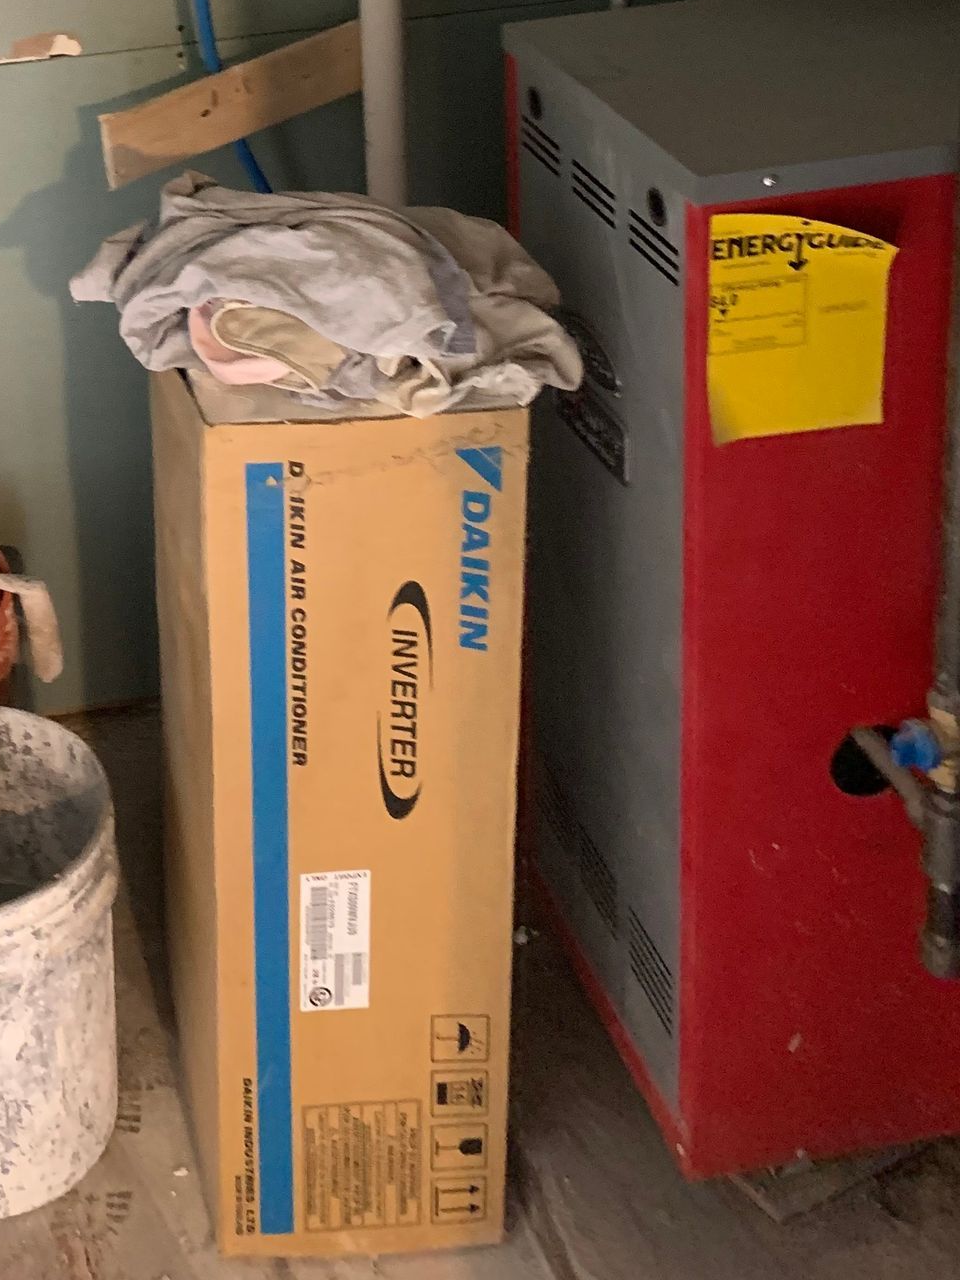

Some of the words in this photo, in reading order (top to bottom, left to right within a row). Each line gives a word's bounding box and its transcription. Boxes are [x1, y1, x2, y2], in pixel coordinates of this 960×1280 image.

[287, 460, 306, 550] DIKIN
[289, 559, 307, 601] AIR
[458, 489, 492, 652] DAIKIN
[289, 607, 308, 766] CONDITIONER
[390, 629, 419, 779] INVERTER
